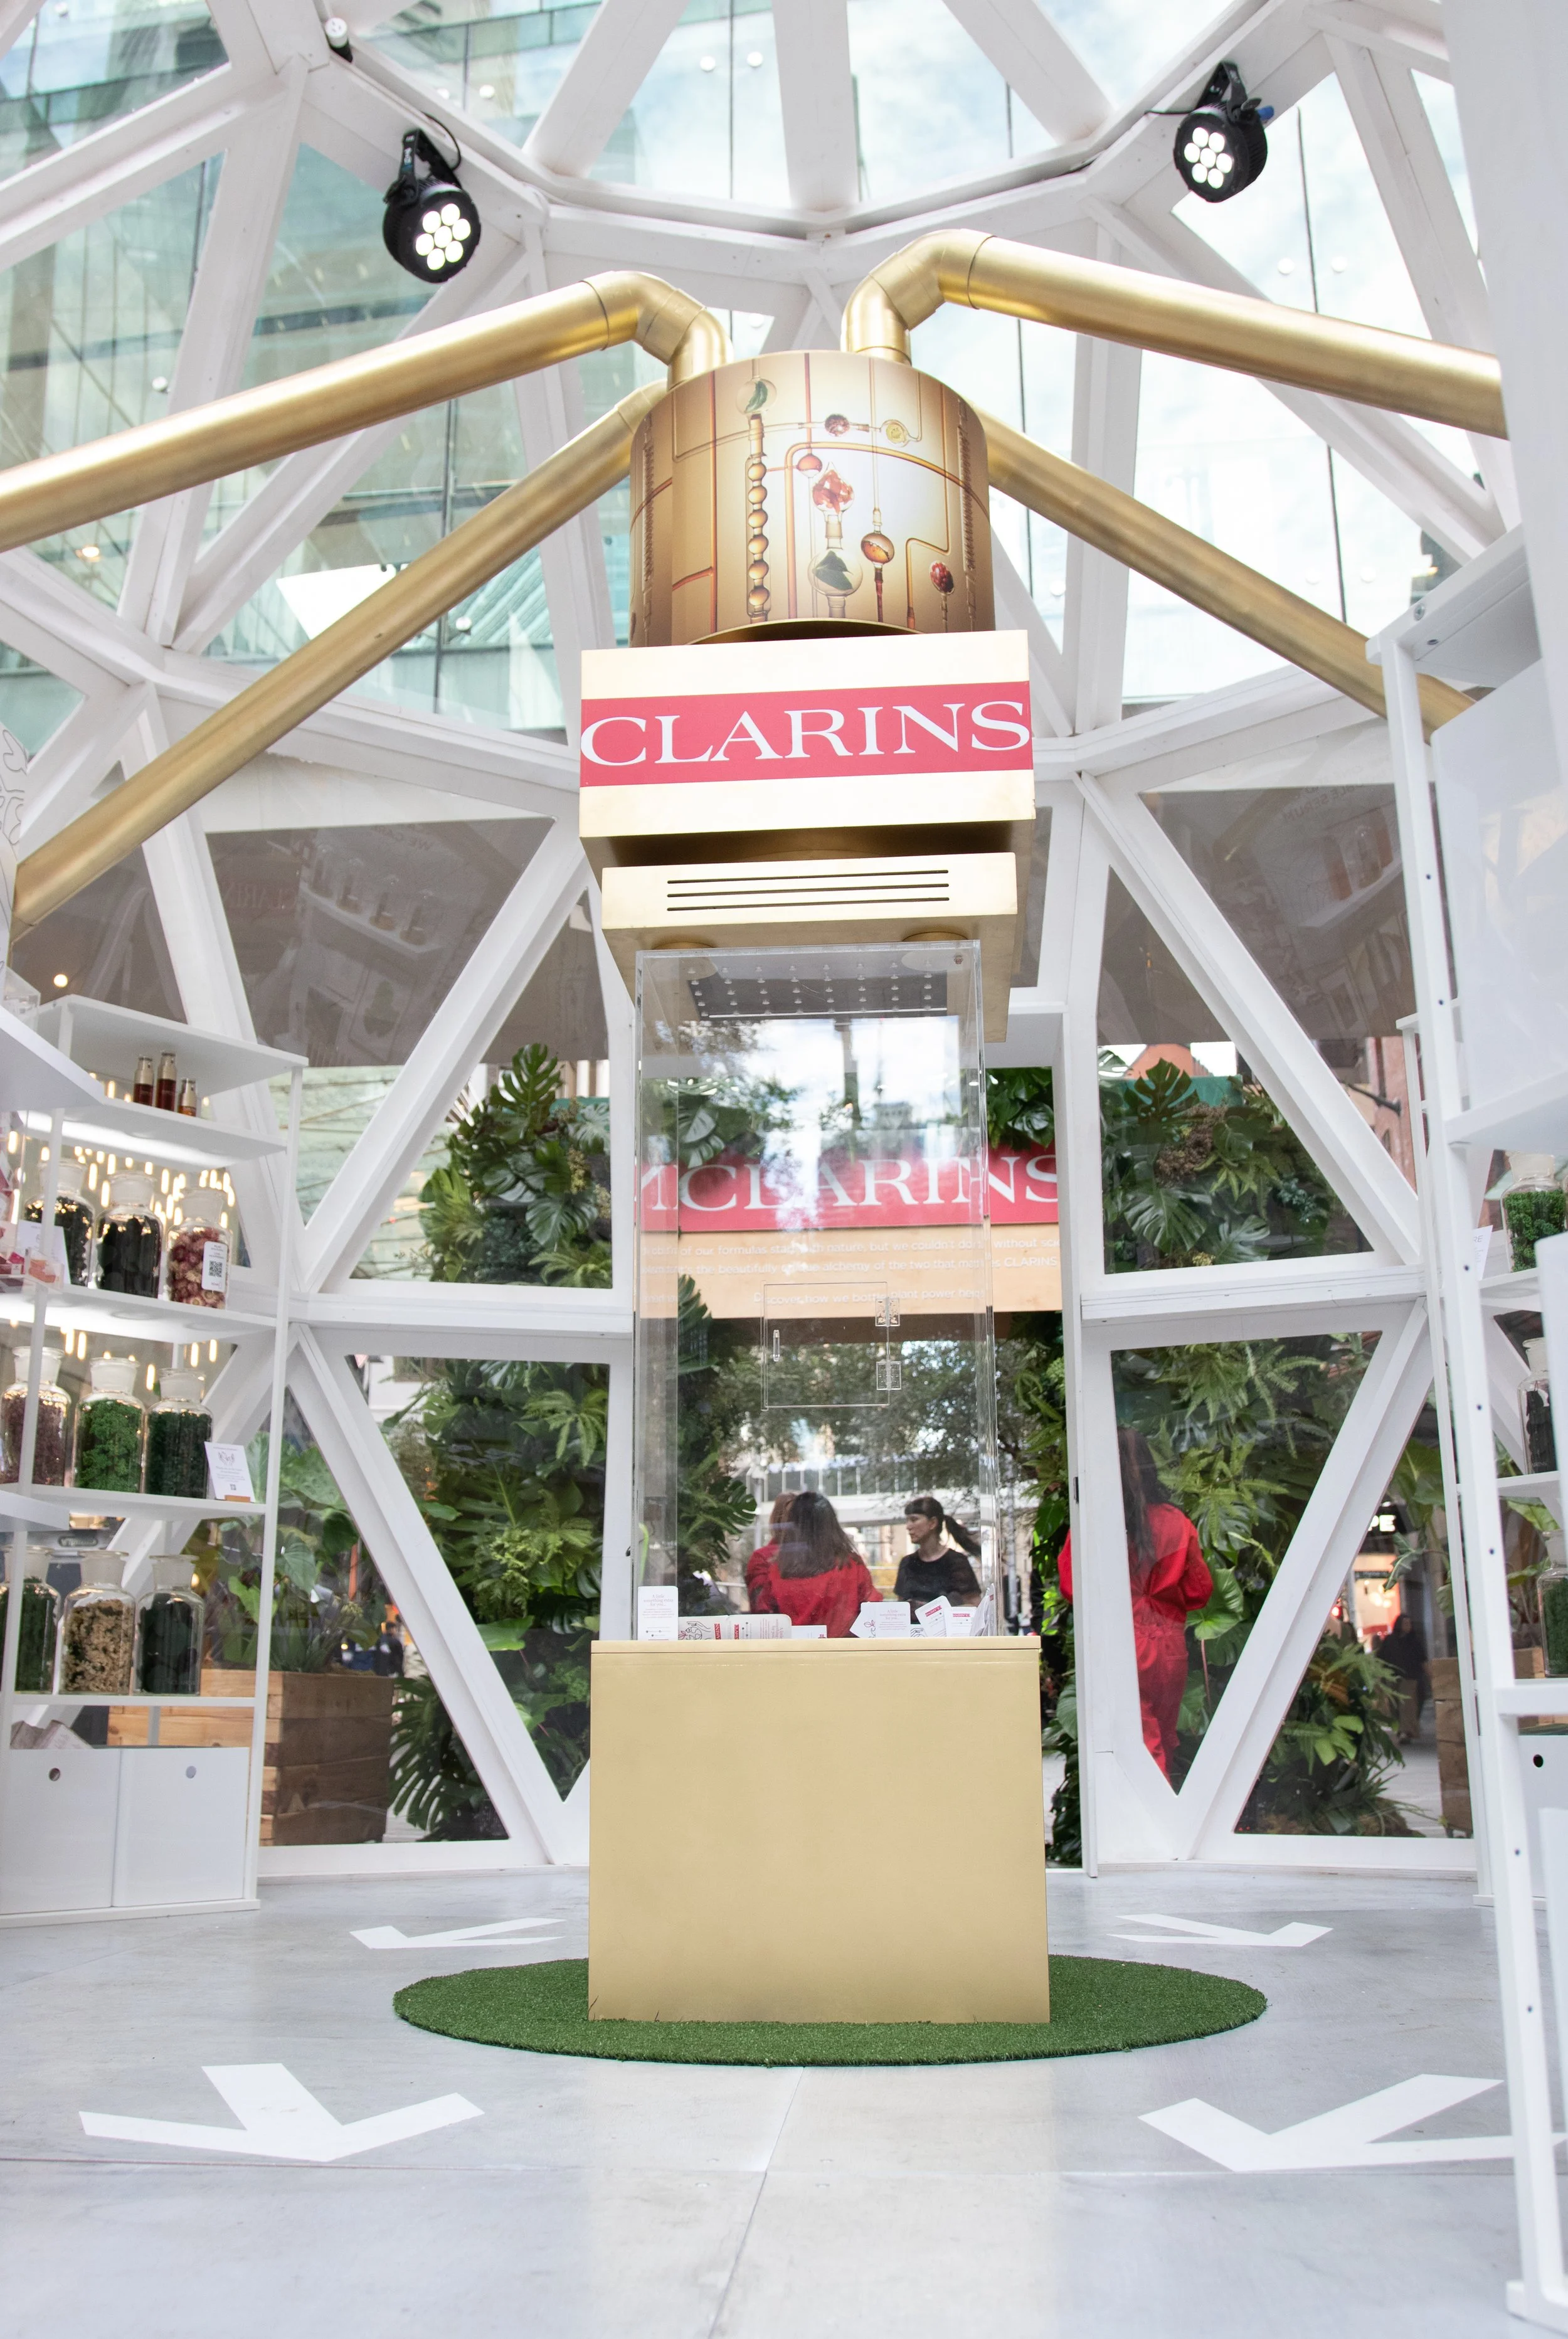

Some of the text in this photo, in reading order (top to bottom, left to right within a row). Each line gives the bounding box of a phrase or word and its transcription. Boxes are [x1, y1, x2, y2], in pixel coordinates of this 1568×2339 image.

[581, 701, 1030, 766] CLARINS
[679, 1155, 1058, 1211] CLARINS
[680, 1246, 692, 1255] of
[695, 1247, 714, 1255] our
[718, 1244, 767, 1255] formulas
[870, 1241, 889, 1252] but
[893, 1243, 908, 1251] we
[994, 1238, 1037, 1248] without
[696, 1265, 715, 1274] the
[719, 1262, 776, 1274] beautifully
[823, 1261, 869, 1272] alchemy
[874, 1260, 887, 1270] of
[889, 1260, 907, 1270] the
[909, 1260, 930, 1269] two
[933, 1258, 956, 1269] that
[1004, 1256, 1057, 1268] CLARINS
[805, 1295, 828, 1303] how
[921, 1289, 955, 1300] power
